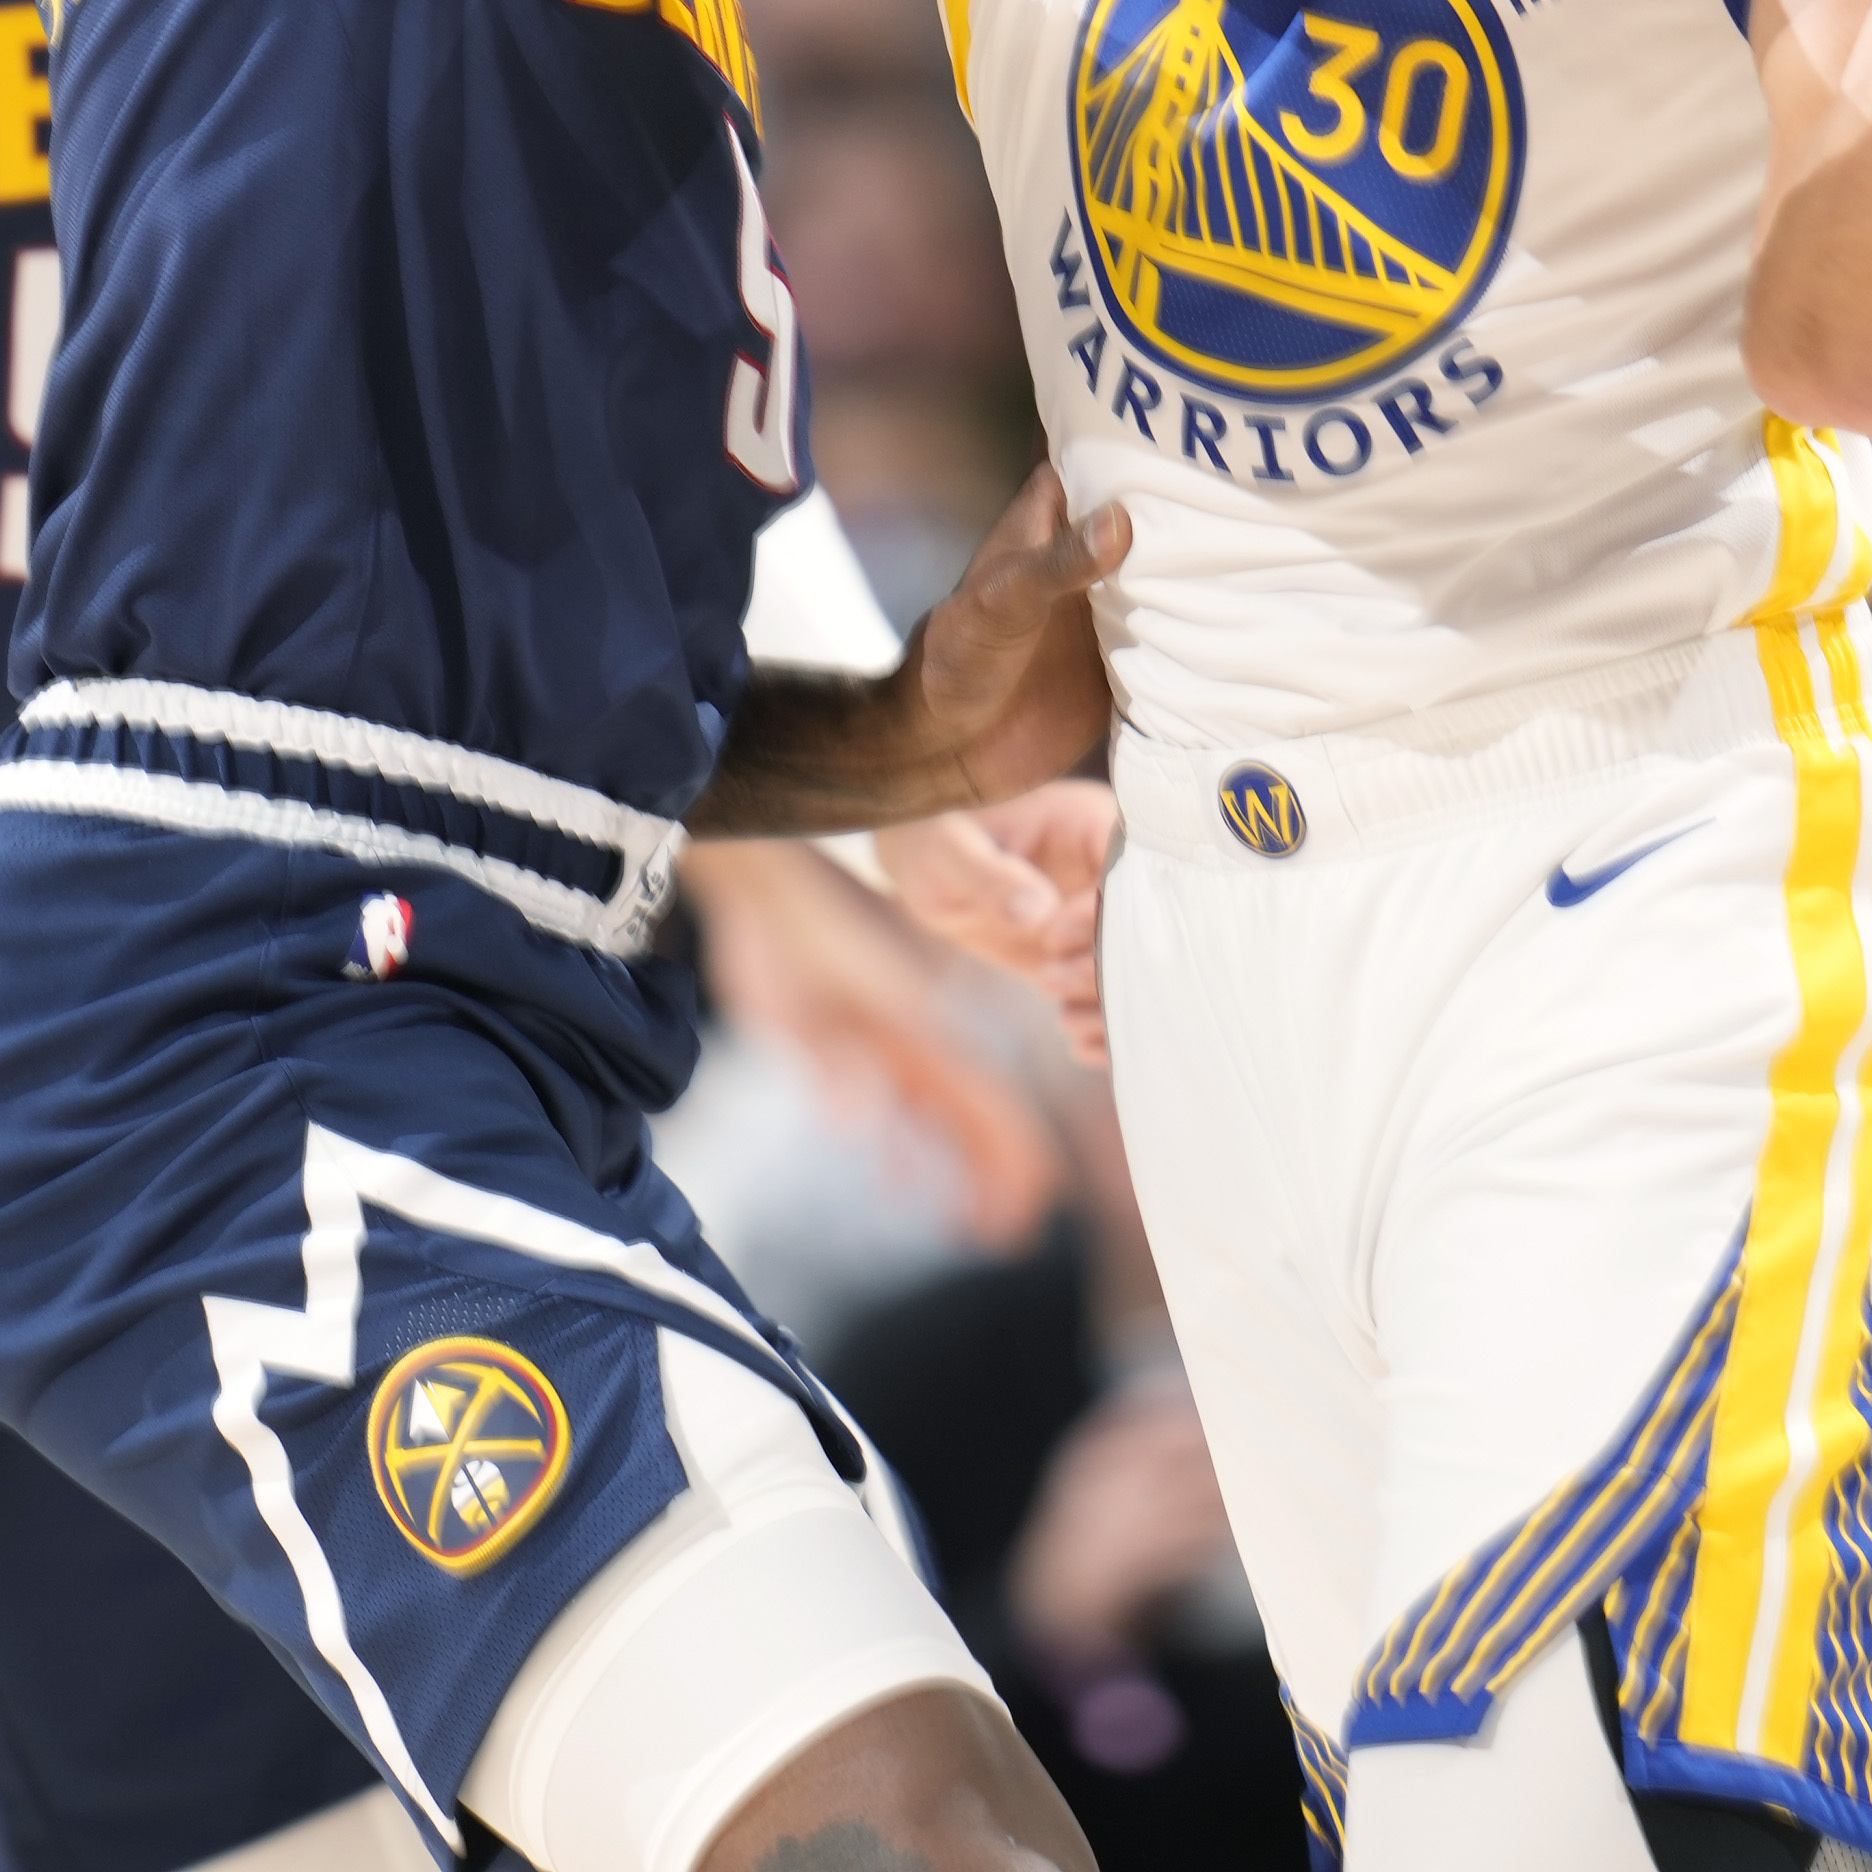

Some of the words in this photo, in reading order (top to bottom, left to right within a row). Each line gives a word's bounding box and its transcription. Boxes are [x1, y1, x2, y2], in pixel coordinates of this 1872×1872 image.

[1278, 10, 1472, 182] 30
[1048, 204, 1505, 486] WARRIORS
[1219, 784, 1294, 850] W
